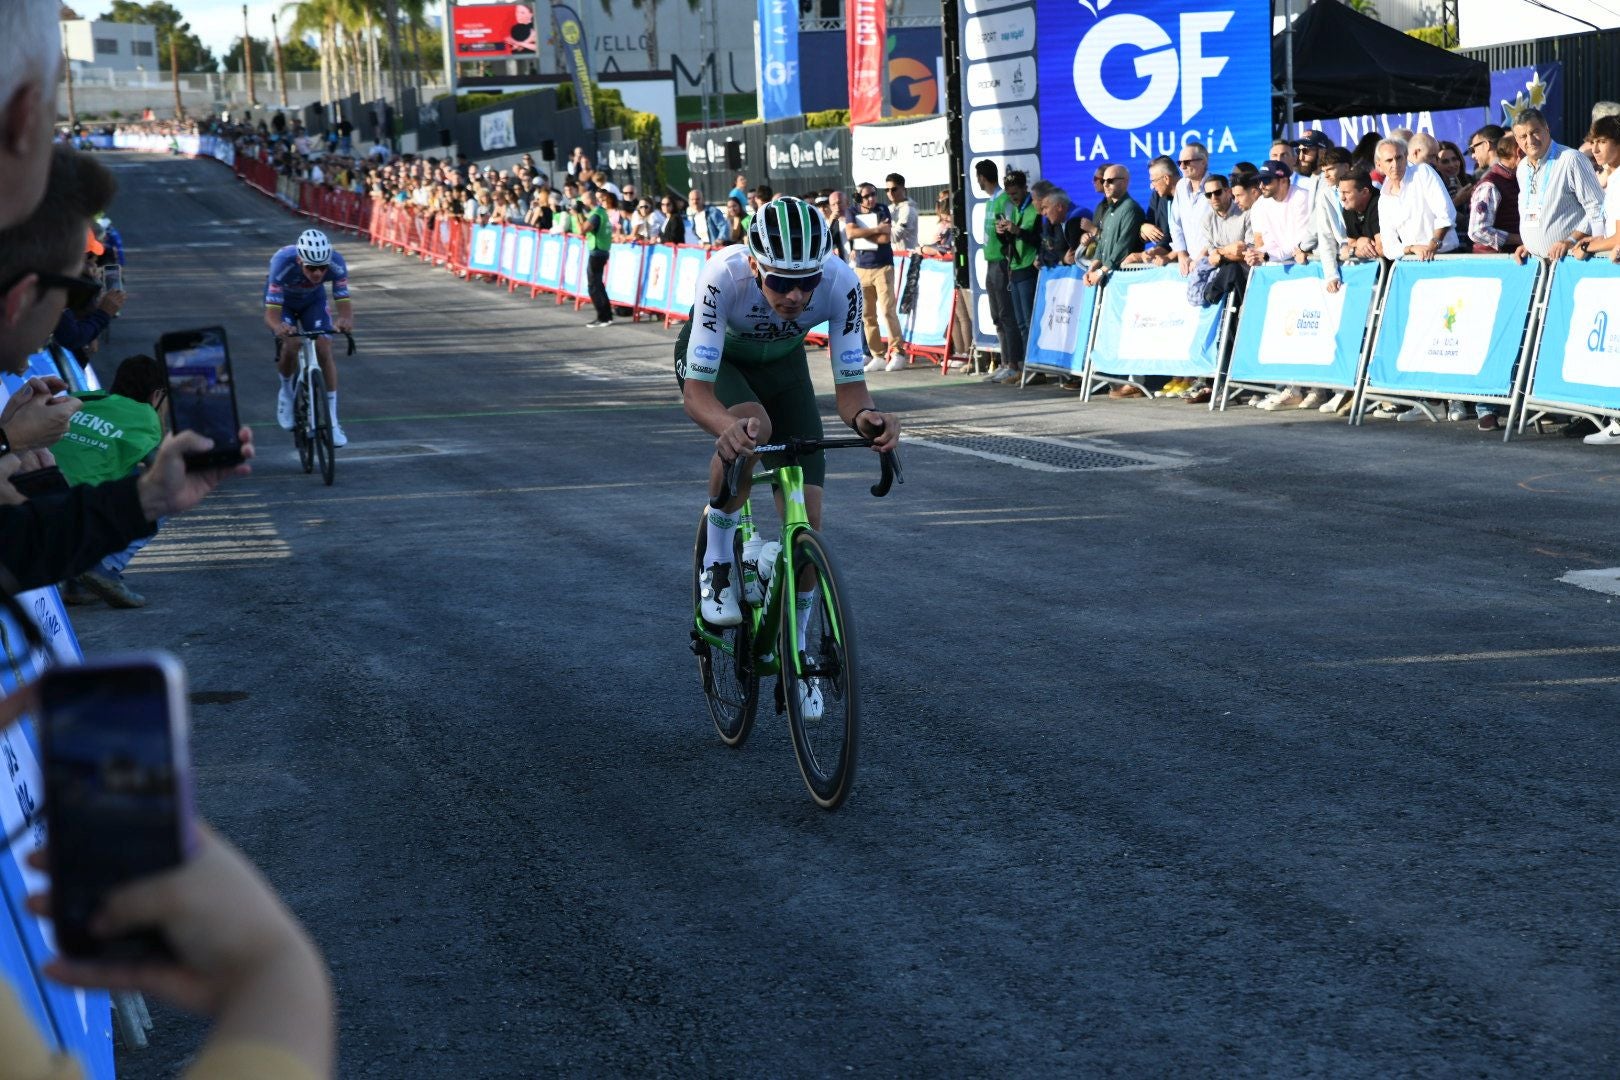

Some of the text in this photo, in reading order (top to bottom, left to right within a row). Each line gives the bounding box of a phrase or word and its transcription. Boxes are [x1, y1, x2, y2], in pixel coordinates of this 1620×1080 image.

[1073, 11, 1235, 130] GF
[1074, 134, 1110, 162] LA
[842, 287, 858, 336] RGA
